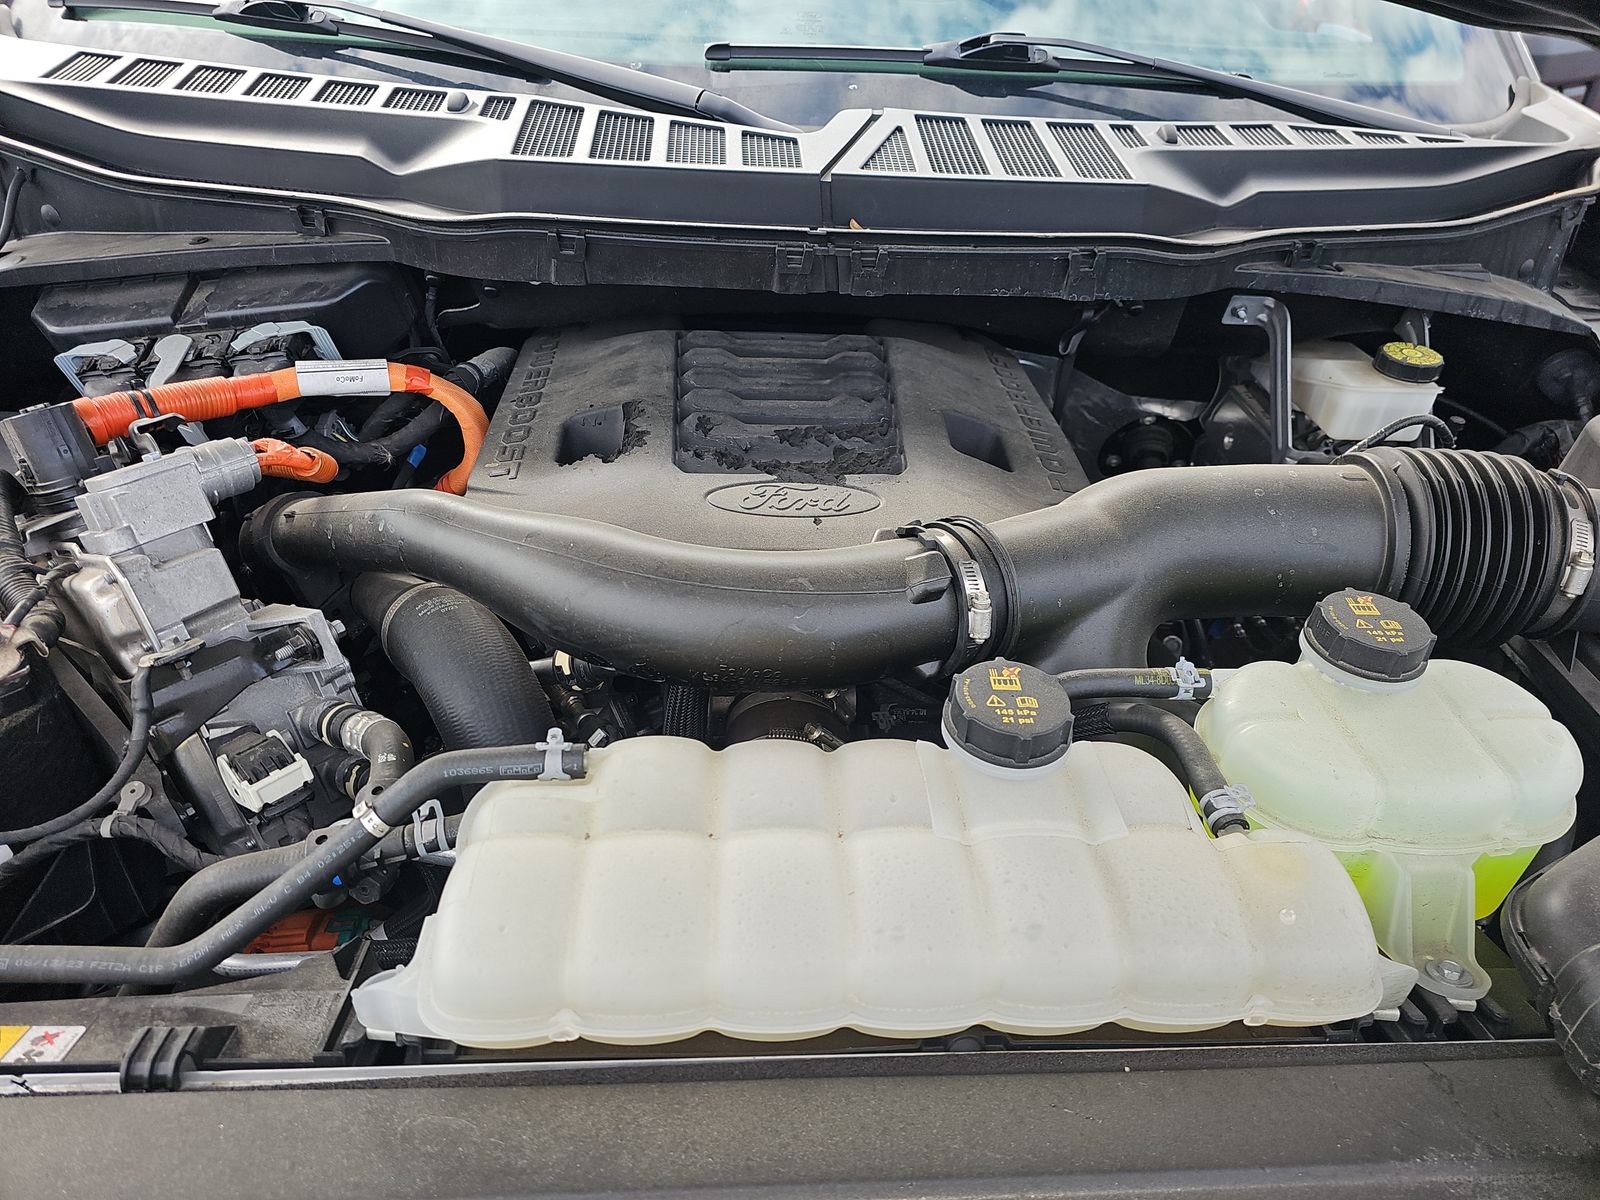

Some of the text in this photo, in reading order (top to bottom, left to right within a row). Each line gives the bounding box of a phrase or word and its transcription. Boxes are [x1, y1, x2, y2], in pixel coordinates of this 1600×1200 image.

[335, 375, 364, 384] FoMoCo
[737, 484, 853, 513] Ford
[994, 708, 1015, 716] 145
[1001, 716, 1034, 725] 21 psi
